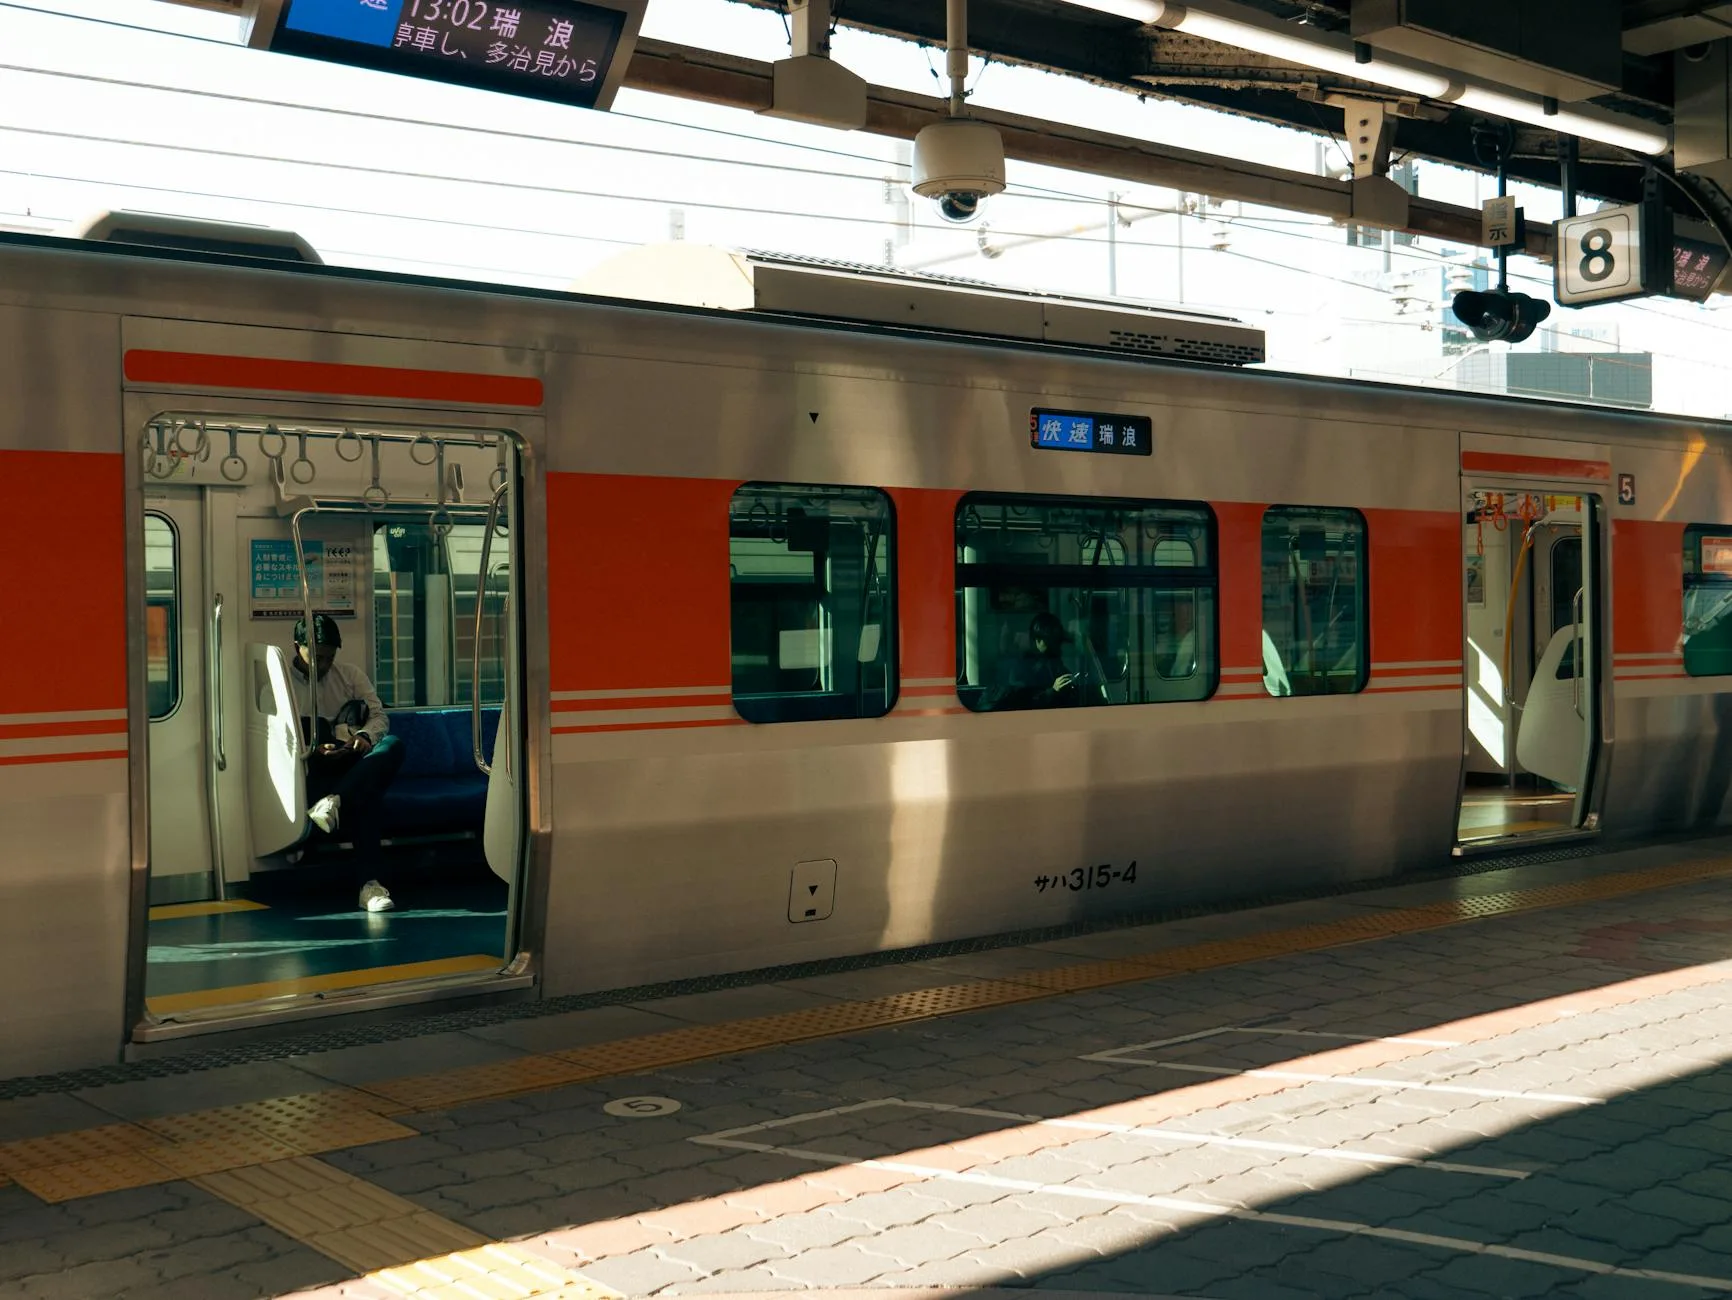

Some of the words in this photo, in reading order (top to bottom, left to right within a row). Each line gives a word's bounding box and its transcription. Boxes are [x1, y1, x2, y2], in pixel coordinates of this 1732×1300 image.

[409, 0, 488, 30] 13:02
[1579, 228, 1615, 282] 8
[1042, 419, 1089, 443] 快速
[1099, 424, 1136, 447] 瑞浪
[1622, 477, 1632, 501] 5
[623, 1100, 662, 1112] 5
